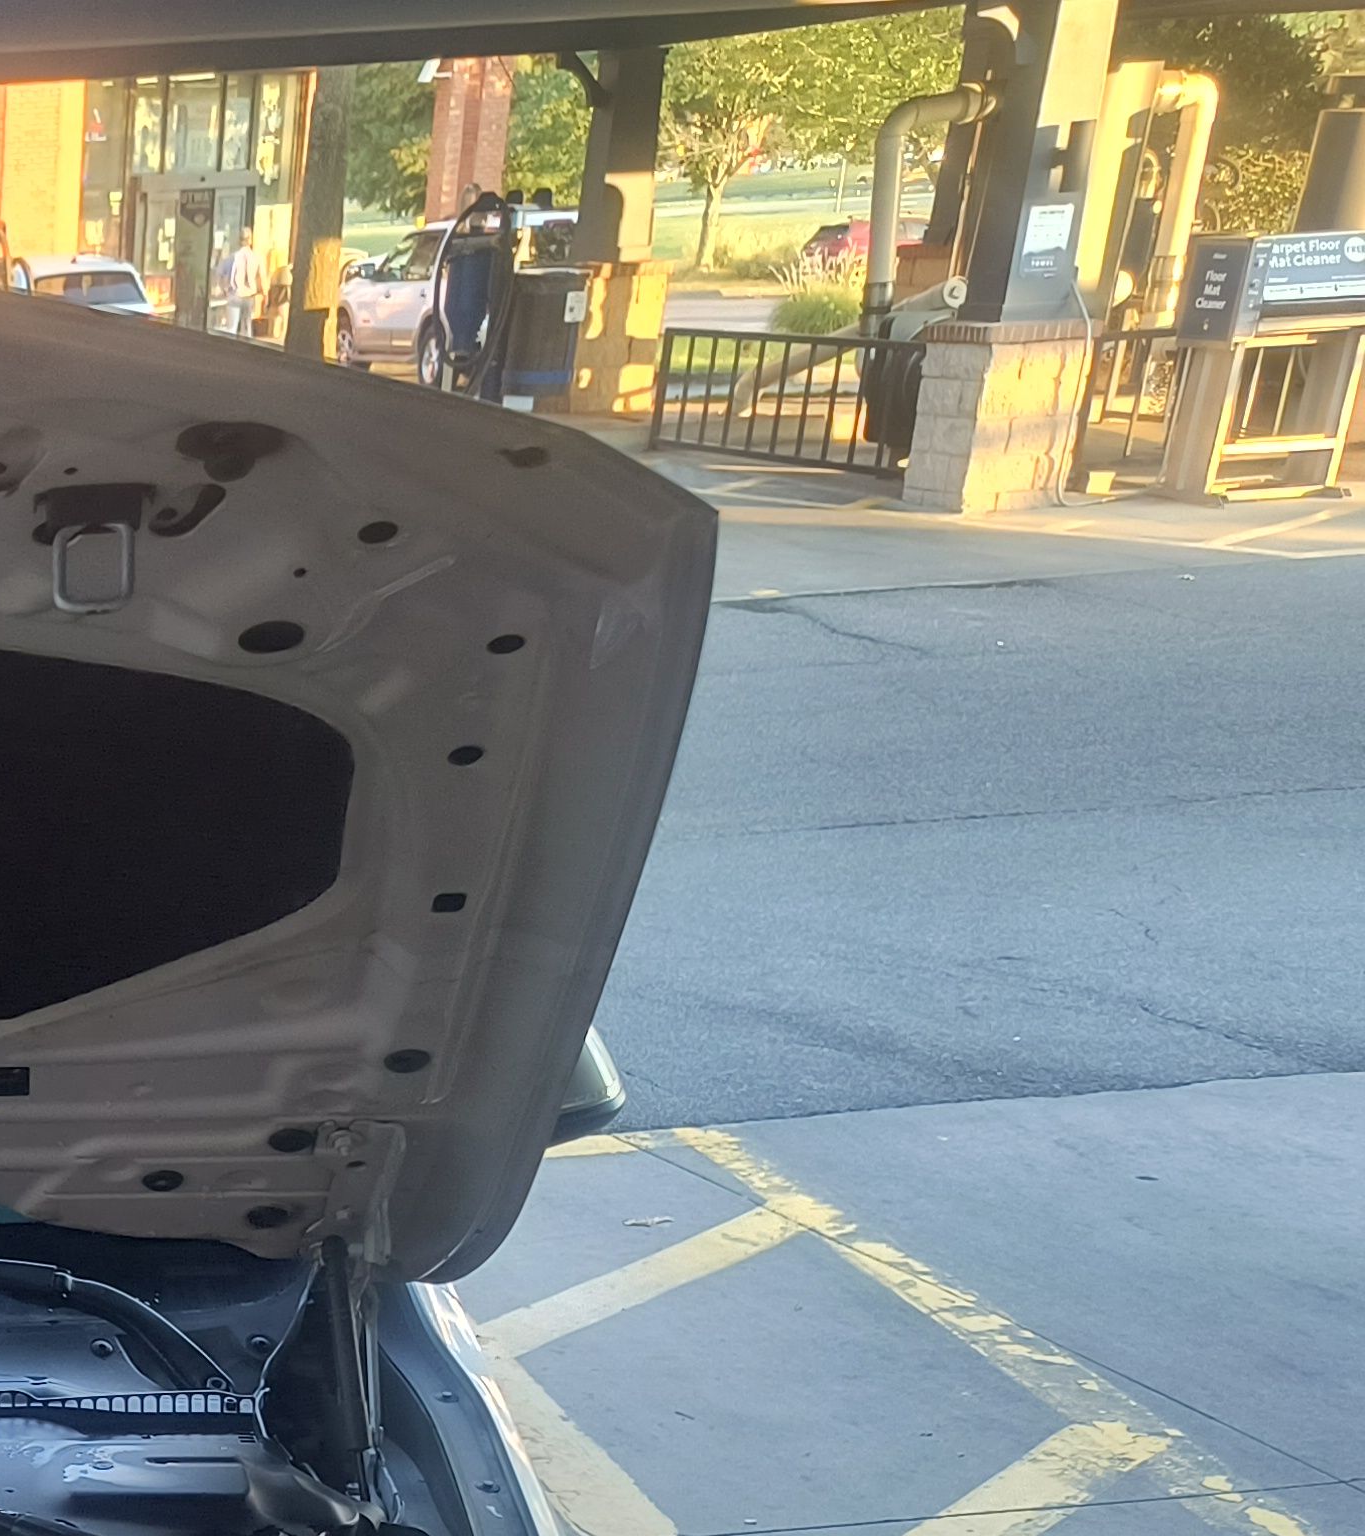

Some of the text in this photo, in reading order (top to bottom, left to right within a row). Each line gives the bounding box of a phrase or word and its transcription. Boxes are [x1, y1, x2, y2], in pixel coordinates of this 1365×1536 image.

[1271, 238, 1341, 255] arpet Floor
[1293, 252, 1341, 267] Cleaner
